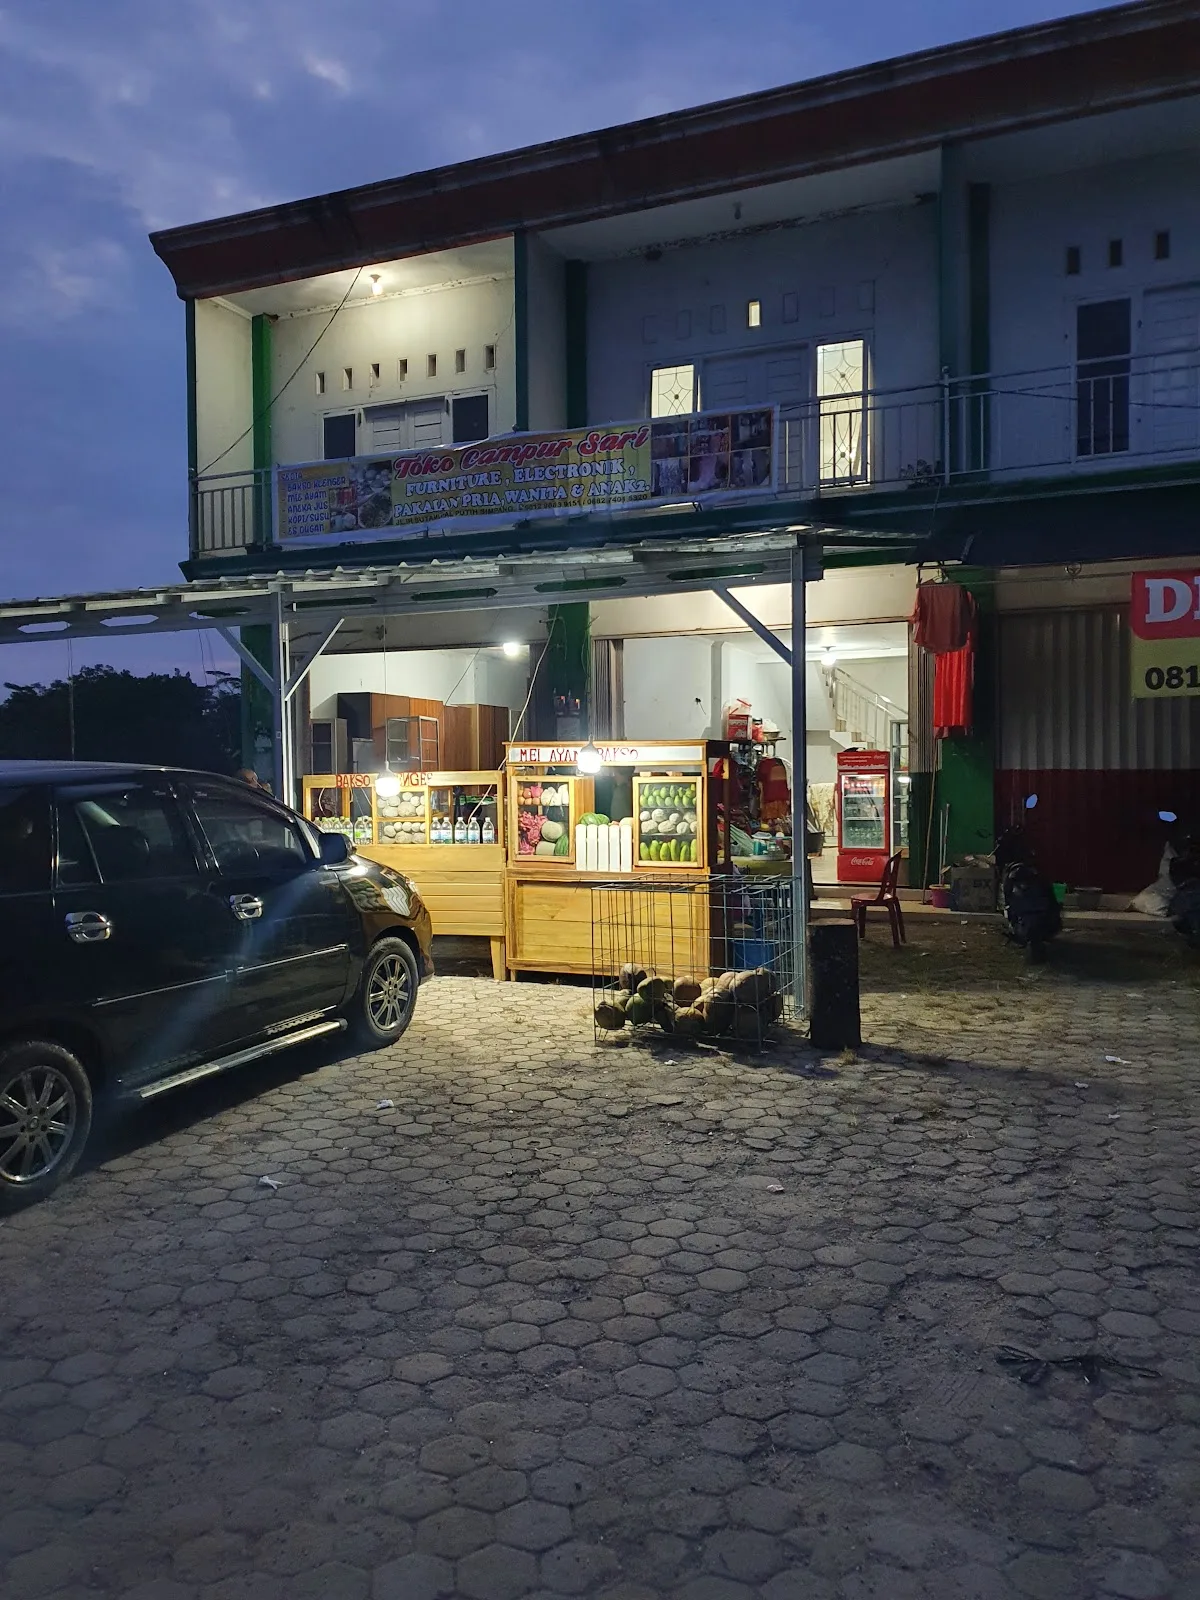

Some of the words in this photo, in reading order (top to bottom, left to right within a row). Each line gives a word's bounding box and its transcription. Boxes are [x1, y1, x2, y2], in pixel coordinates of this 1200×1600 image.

[394, 455, 454, 480] Toko
[461, 438, 573, 470] Campur
[577, 425, 650, 456] Sari
[287, 481, 312, 492] BAKSO
[288, 493, 303, 503] MIE
[304, 490, 328, 501] AYAM
[394, 496, 460, 517] PAKAIAN
[570, 484, 585, 498] &
[288, 503, 312, 514] ANEKA
[313, 501, 329, 511] JUS
[1145, 574, 1200, 624] D
[336, 774, 371, 788] BAKSO
